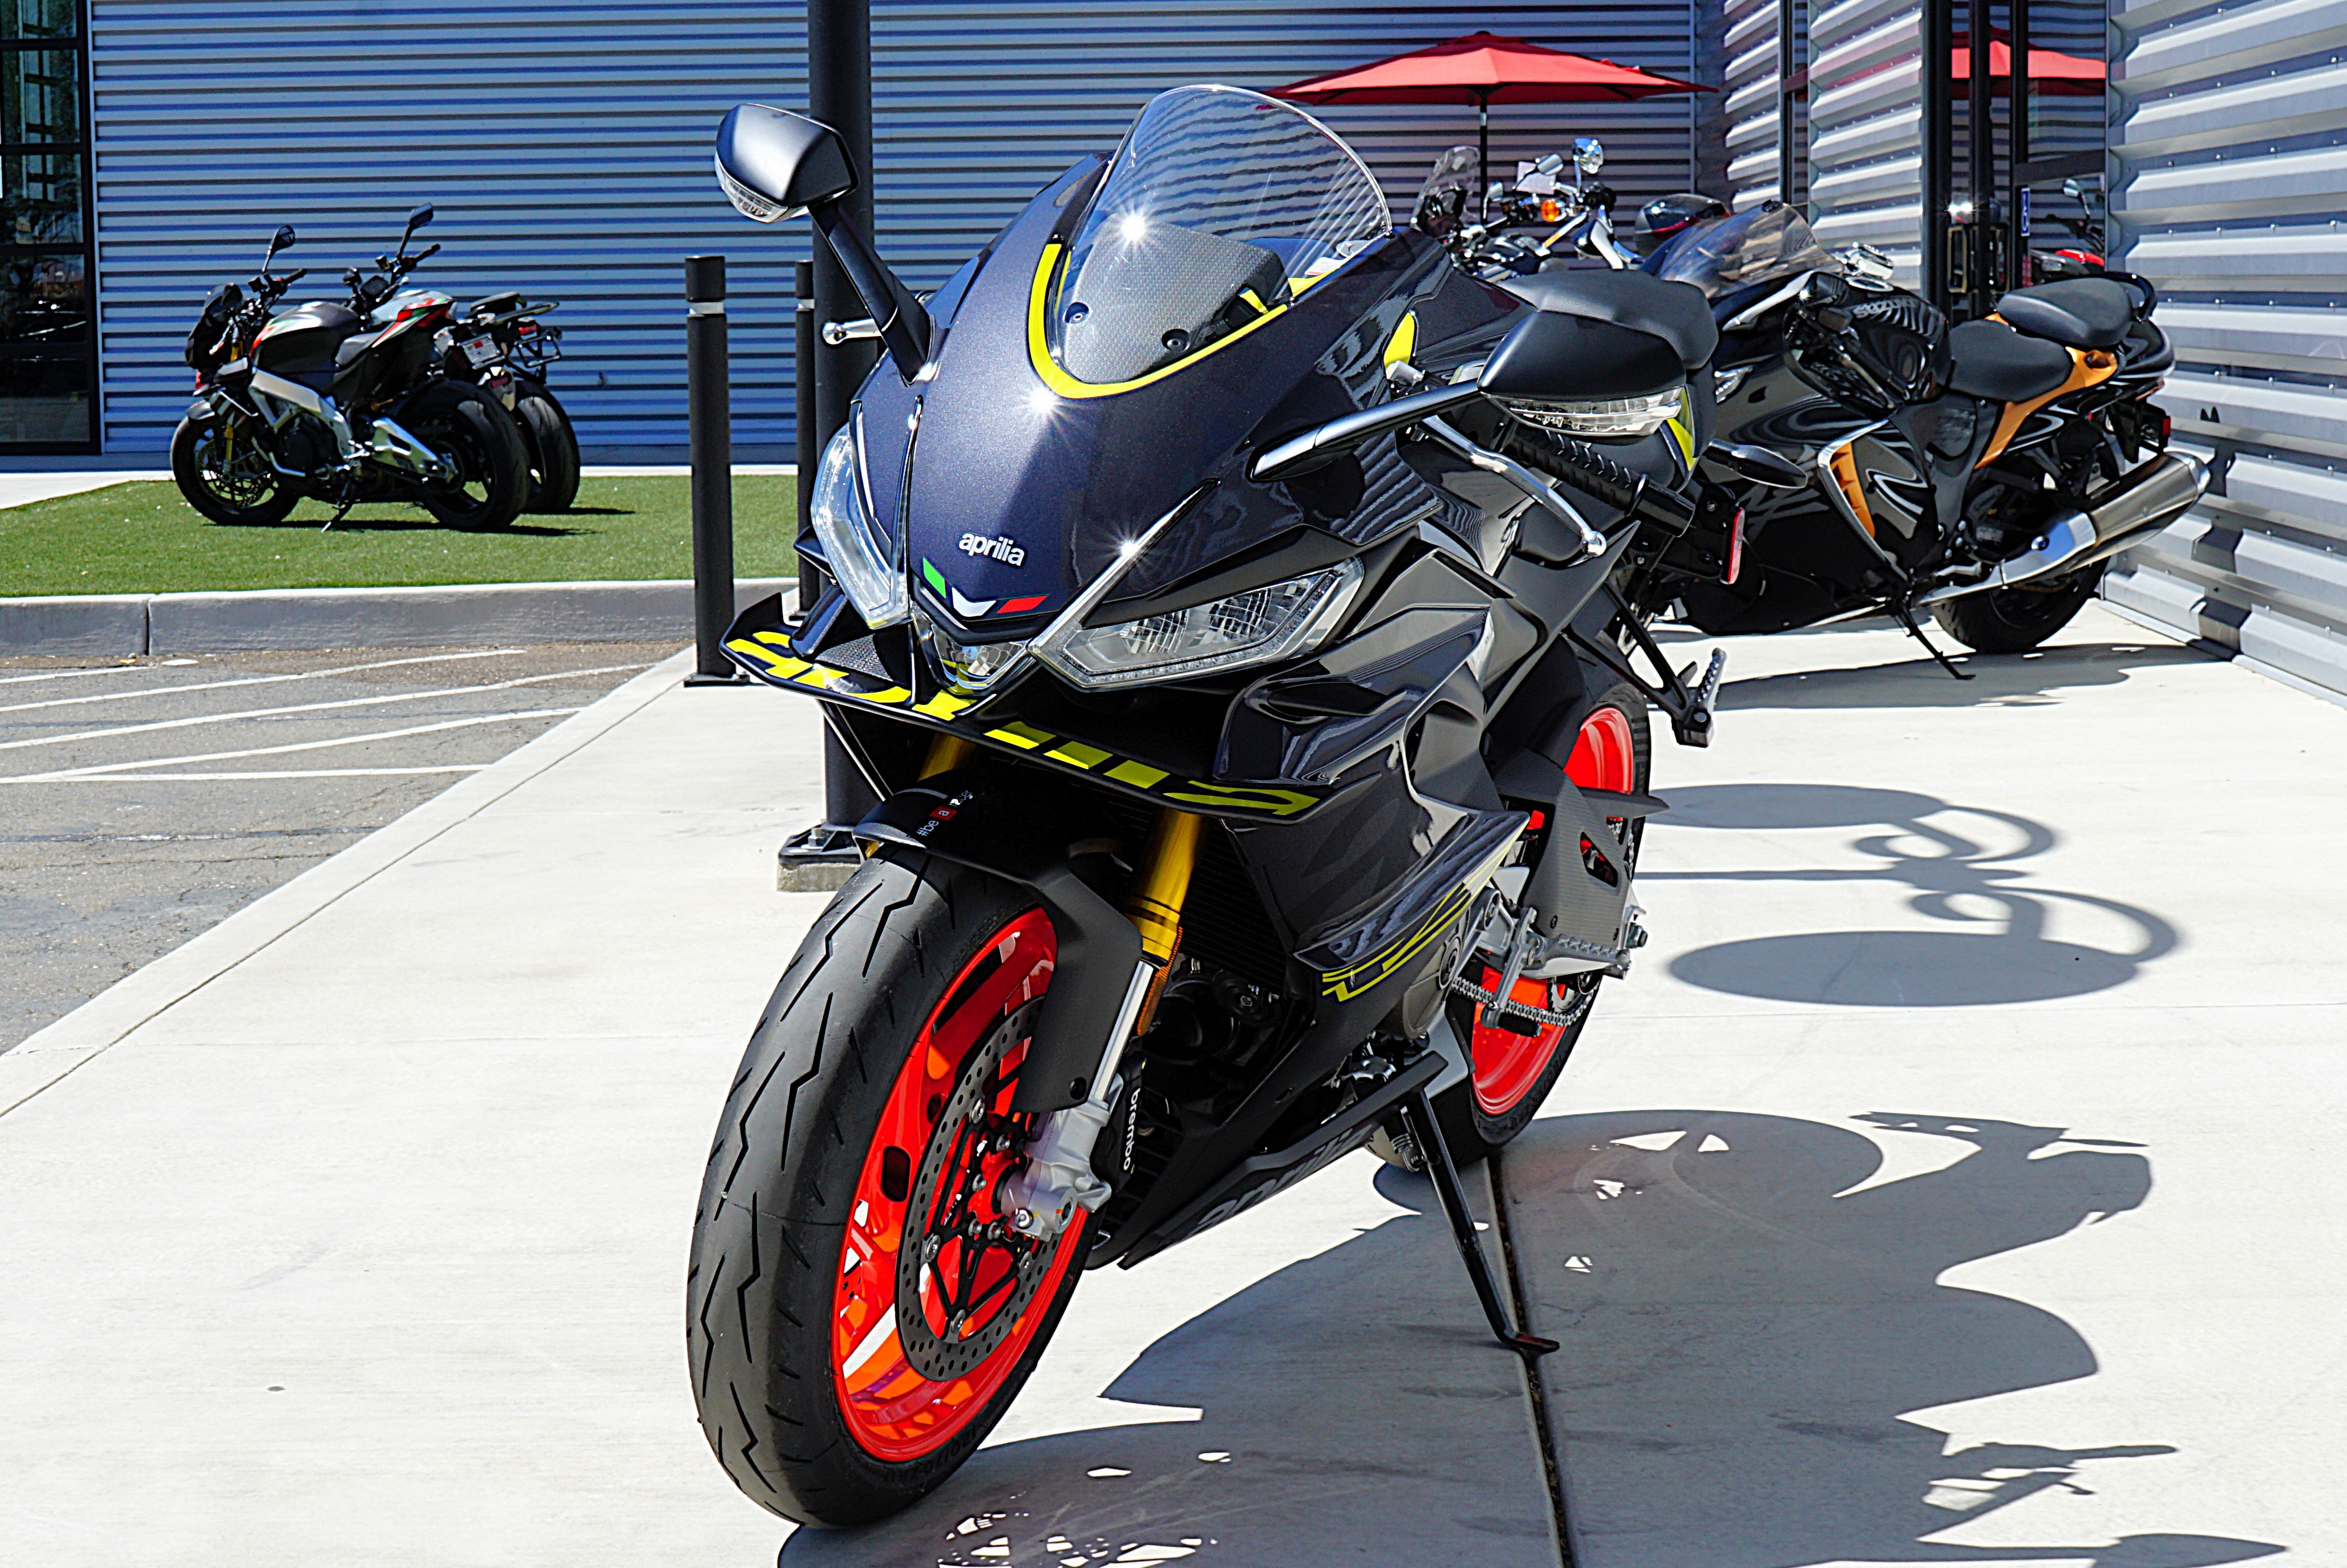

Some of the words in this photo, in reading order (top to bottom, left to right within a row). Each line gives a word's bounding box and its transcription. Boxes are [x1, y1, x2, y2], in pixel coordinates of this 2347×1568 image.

[958, 533, 1025, 566] aprilia
[916, 820, 939, 837] #be
[1123, 1087, 1141, 1170] brembo
